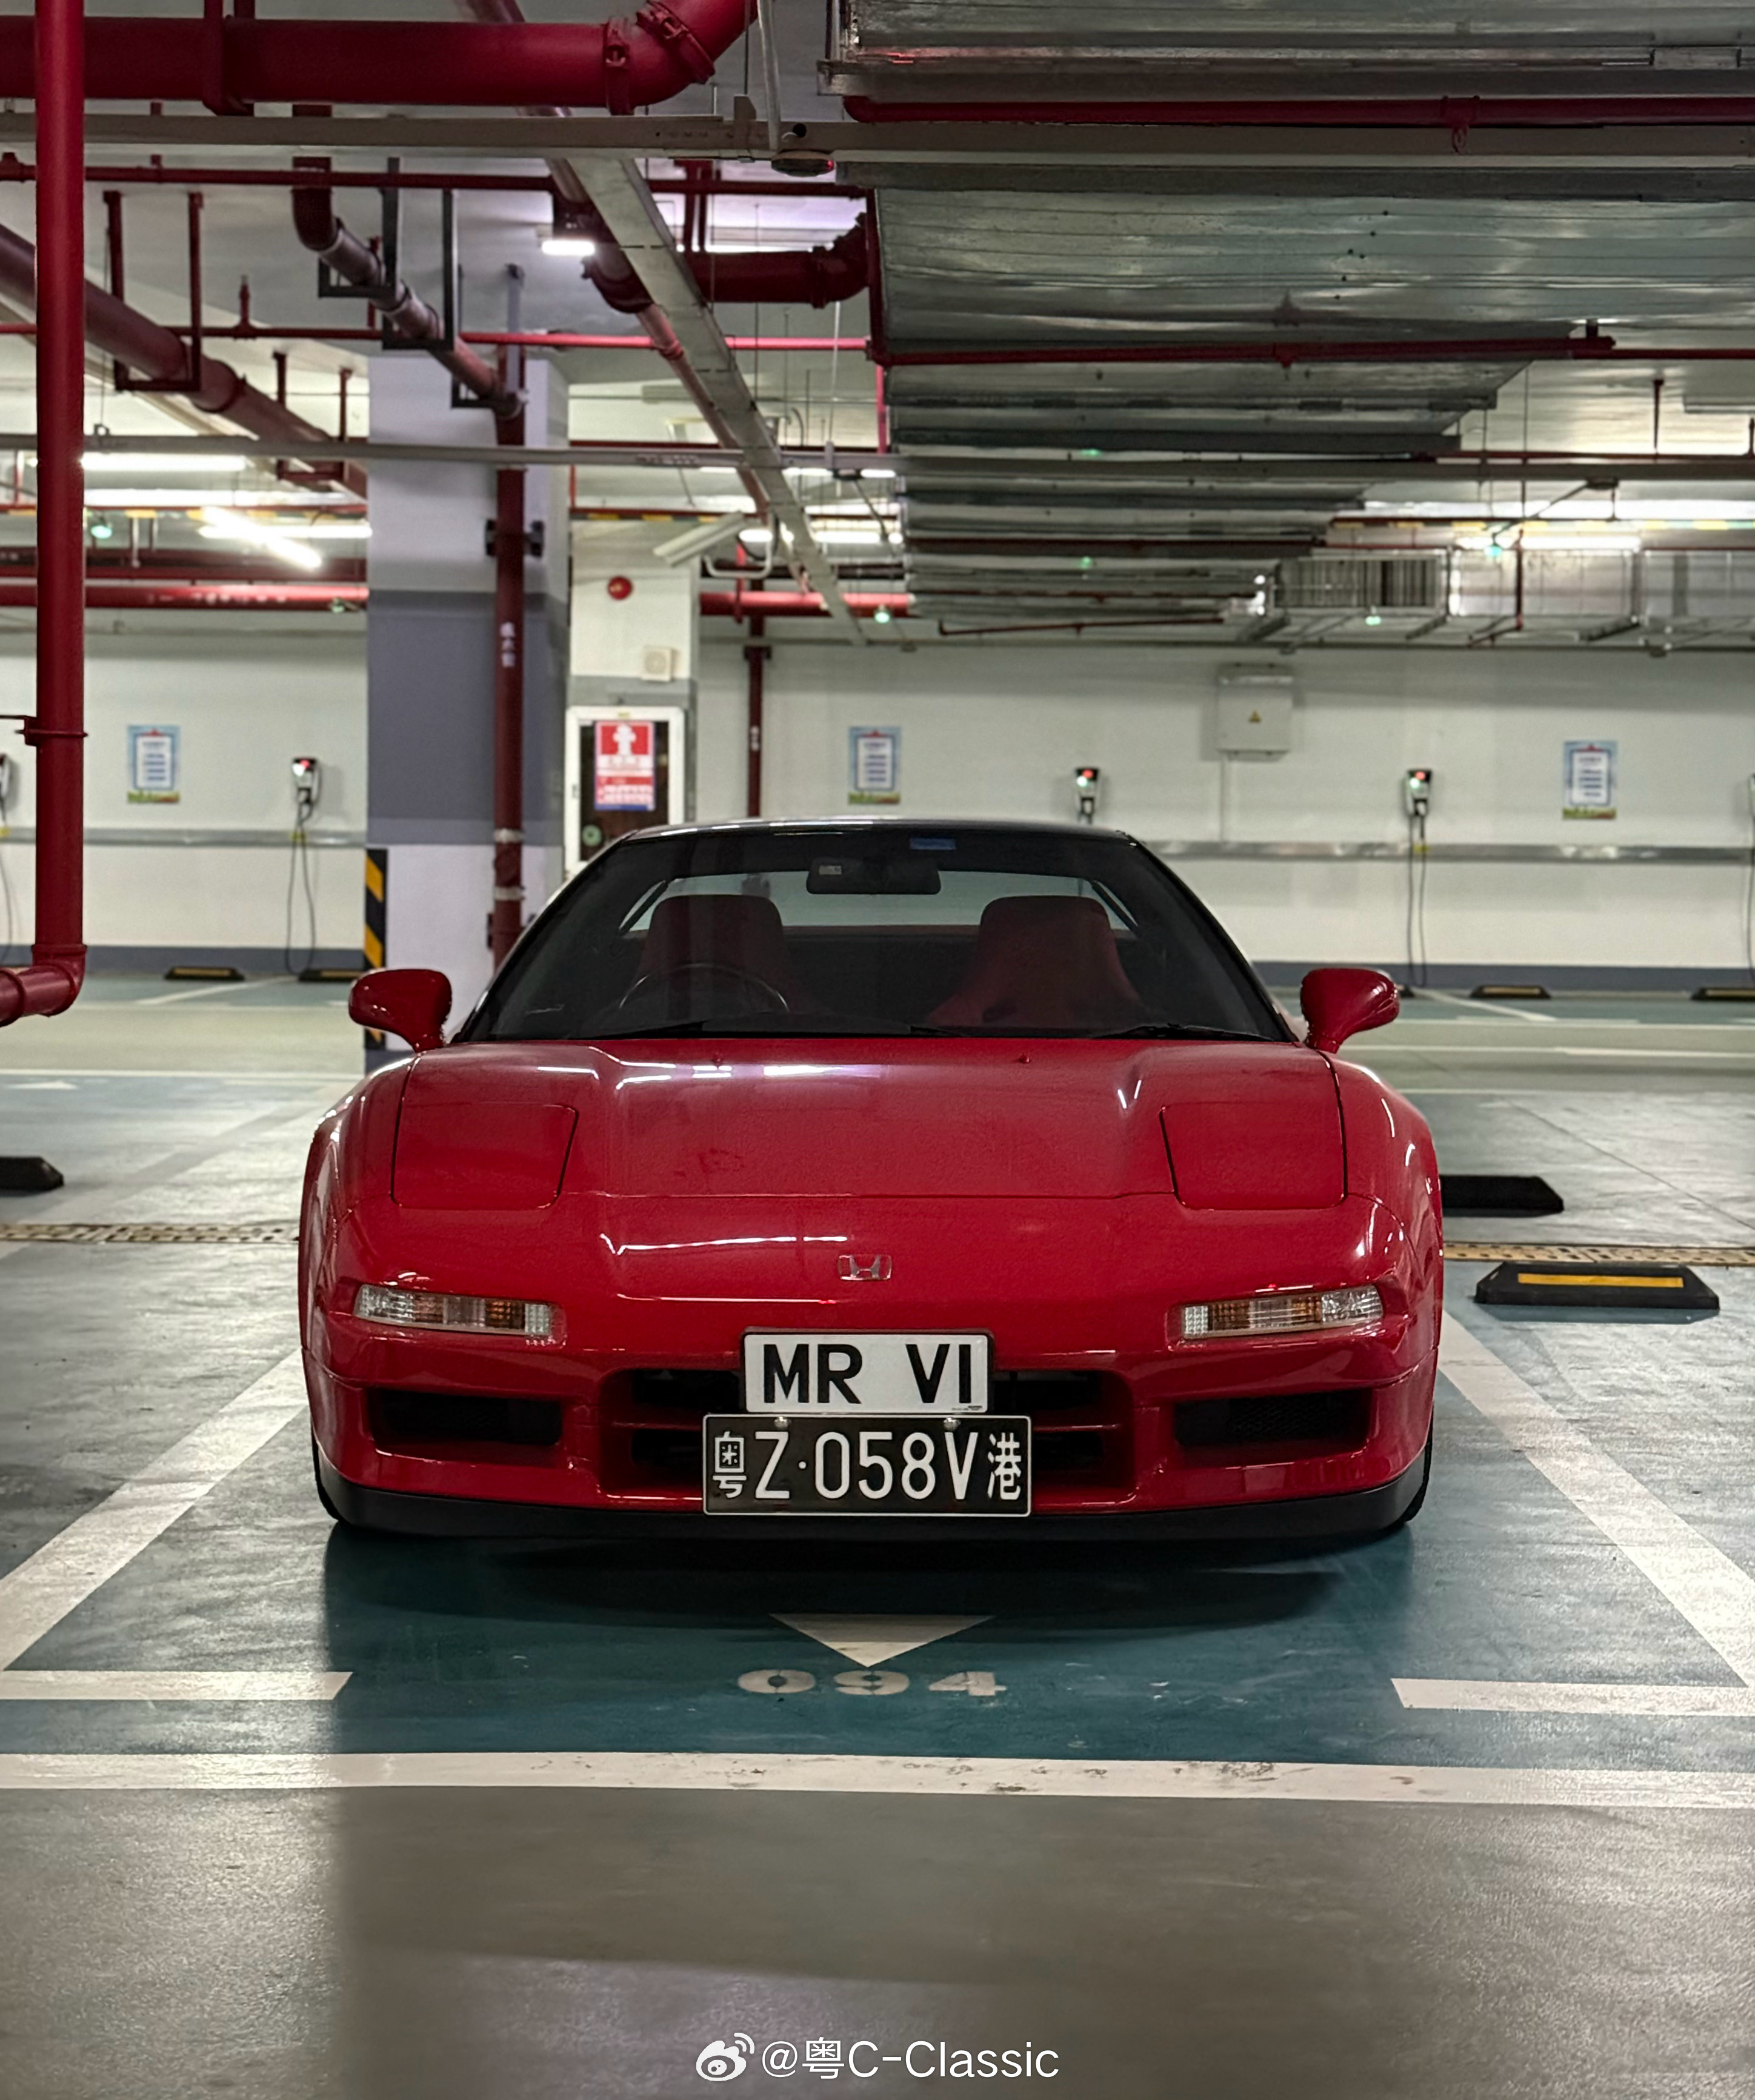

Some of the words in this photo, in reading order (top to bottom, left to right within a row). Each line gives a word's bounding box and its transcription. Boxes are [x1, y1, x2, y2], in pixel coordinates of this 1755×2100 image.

[763, 1343, 863, 1404] MR
[905, 1343, 972, 1404] VI
[737, 1669, 1008, 1696] 094
